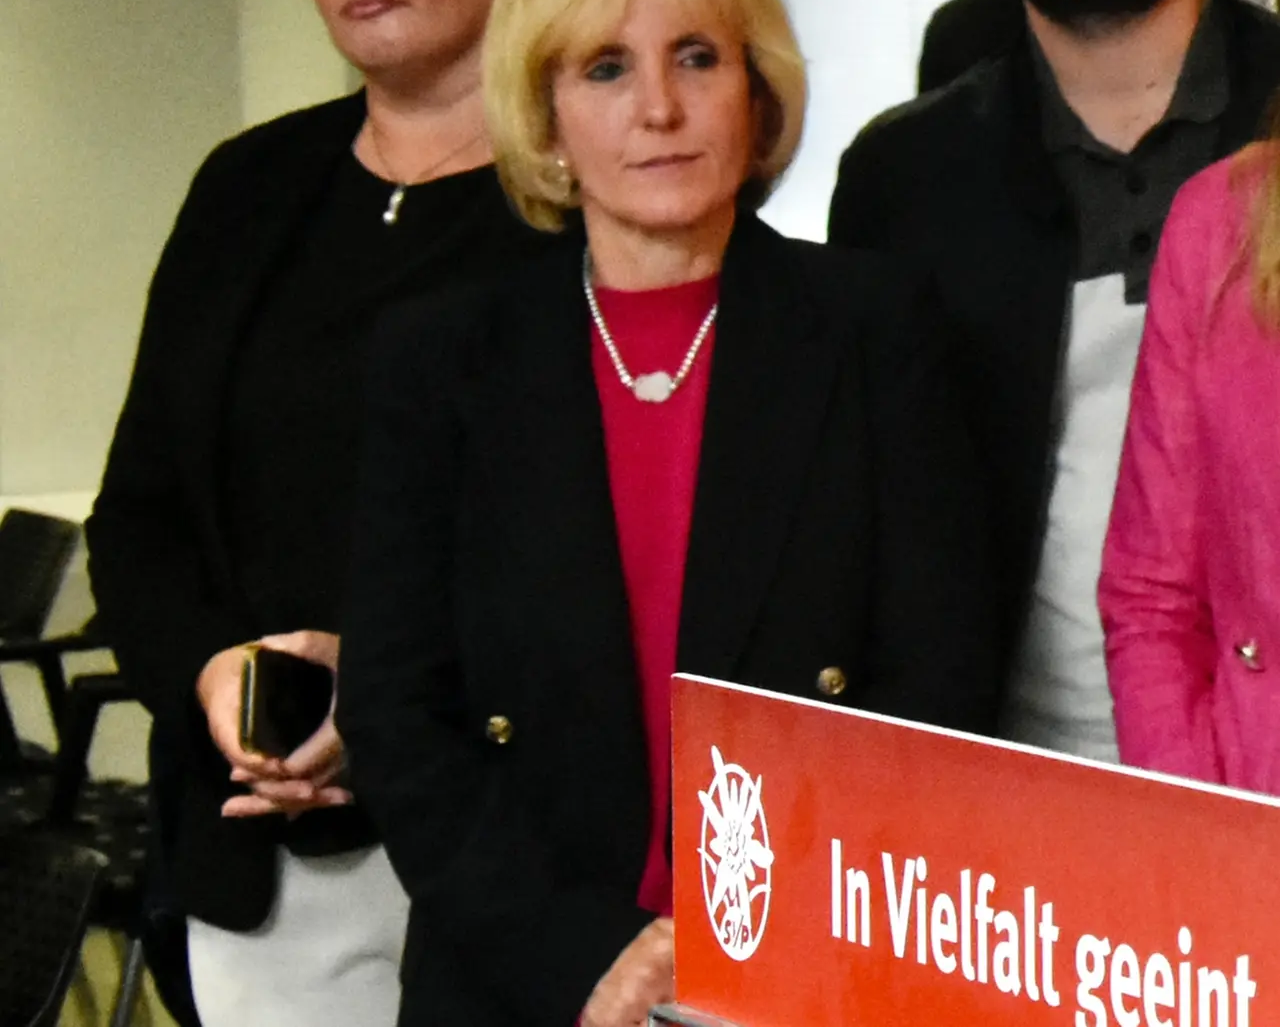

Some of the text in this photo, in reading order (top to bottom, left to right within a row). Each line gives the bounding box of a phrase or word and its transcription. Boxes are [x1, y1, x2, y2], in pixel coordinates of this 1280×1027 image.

[831, 837, 1257, 1027] In Vielfalt geeint
